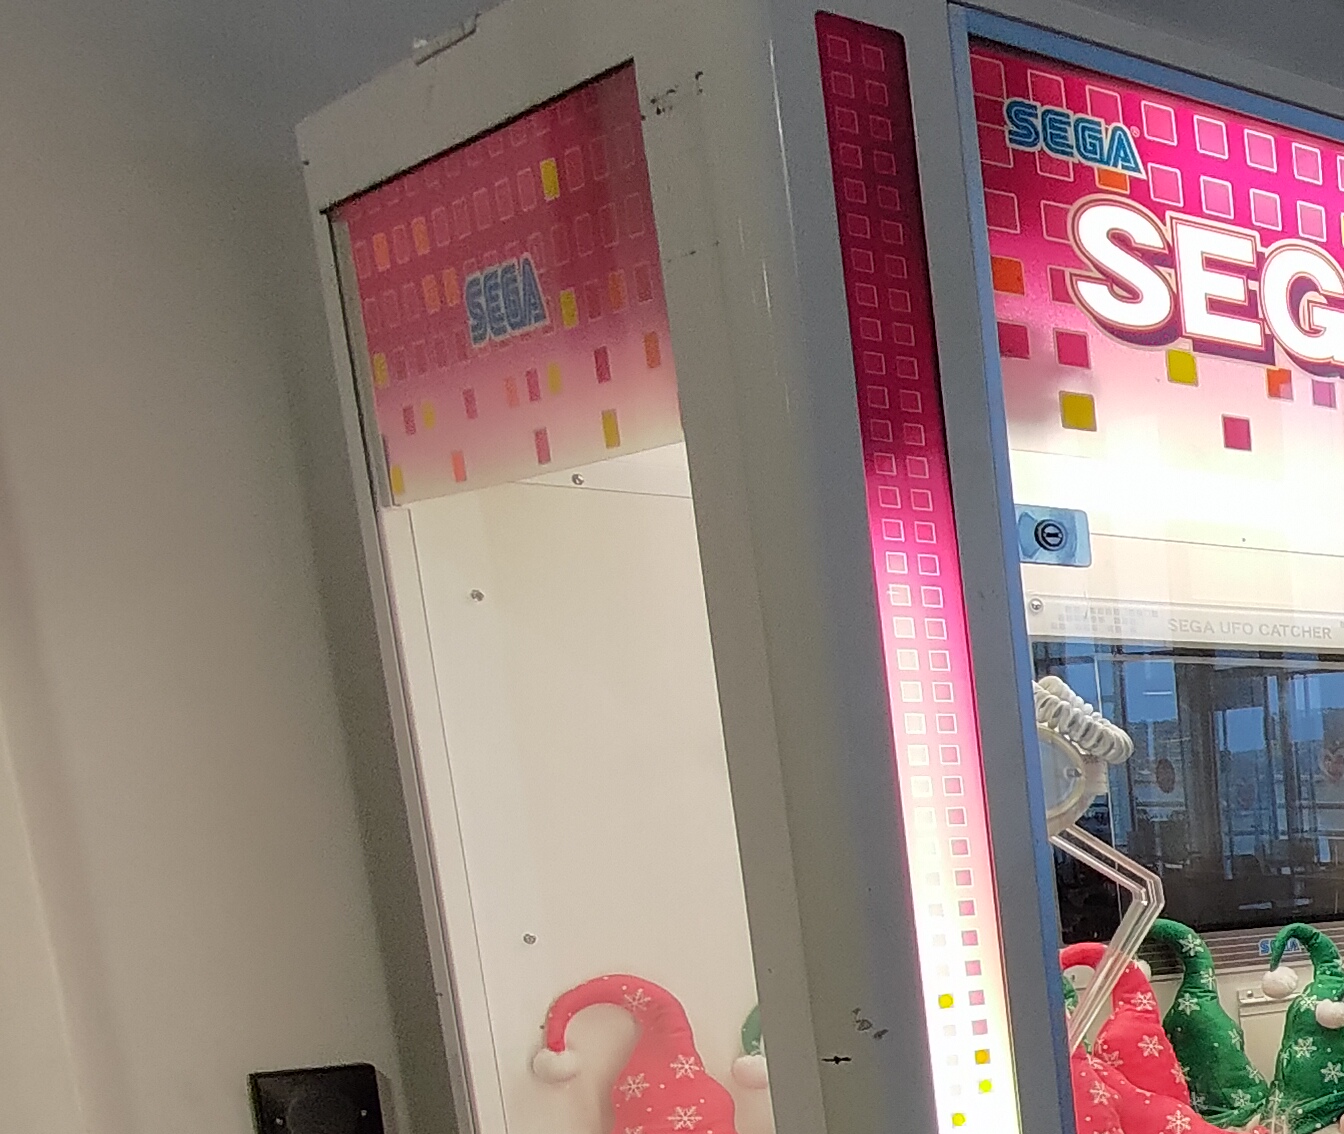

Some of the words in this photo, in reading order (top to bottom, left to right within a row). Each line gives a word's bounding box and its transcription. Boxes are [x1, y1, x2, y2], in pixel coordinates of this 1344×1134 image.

[1003, 97, 1143, 178] SEGA
[464, 252, 551, 348] SEGA
[1168, 618, 1215, 635] SEGA
[1221, 621, 1254, 637] UFO
[1259, 623, 1332, 641] CATCHER
